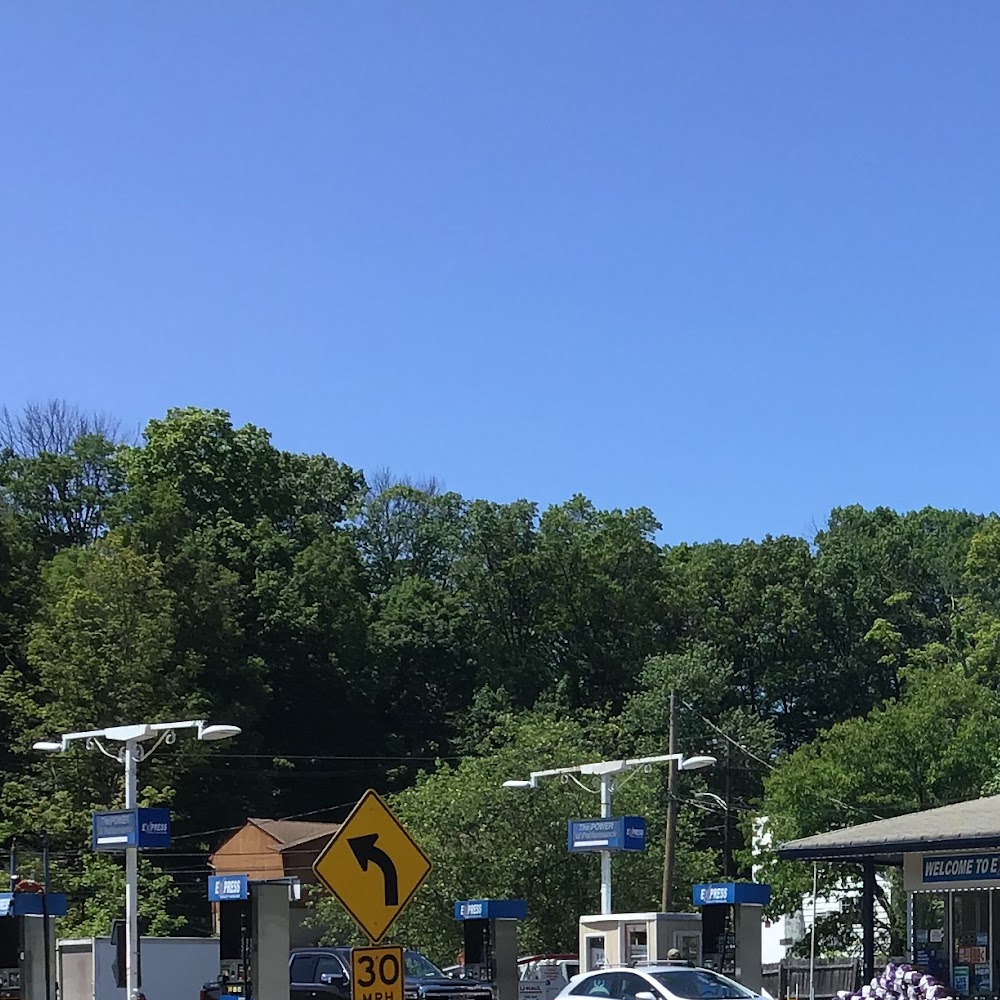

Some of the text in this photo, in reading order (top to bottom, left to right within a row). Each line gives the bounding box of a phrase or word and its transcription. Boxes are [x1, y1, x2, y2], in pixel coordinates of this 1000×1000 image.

[925, 859, 974, 876] WELCOME
[975, 858, 990, 874] TO
[700, 885, 728, 901] EXPRESS
[357, 954, 400, 987] 30
